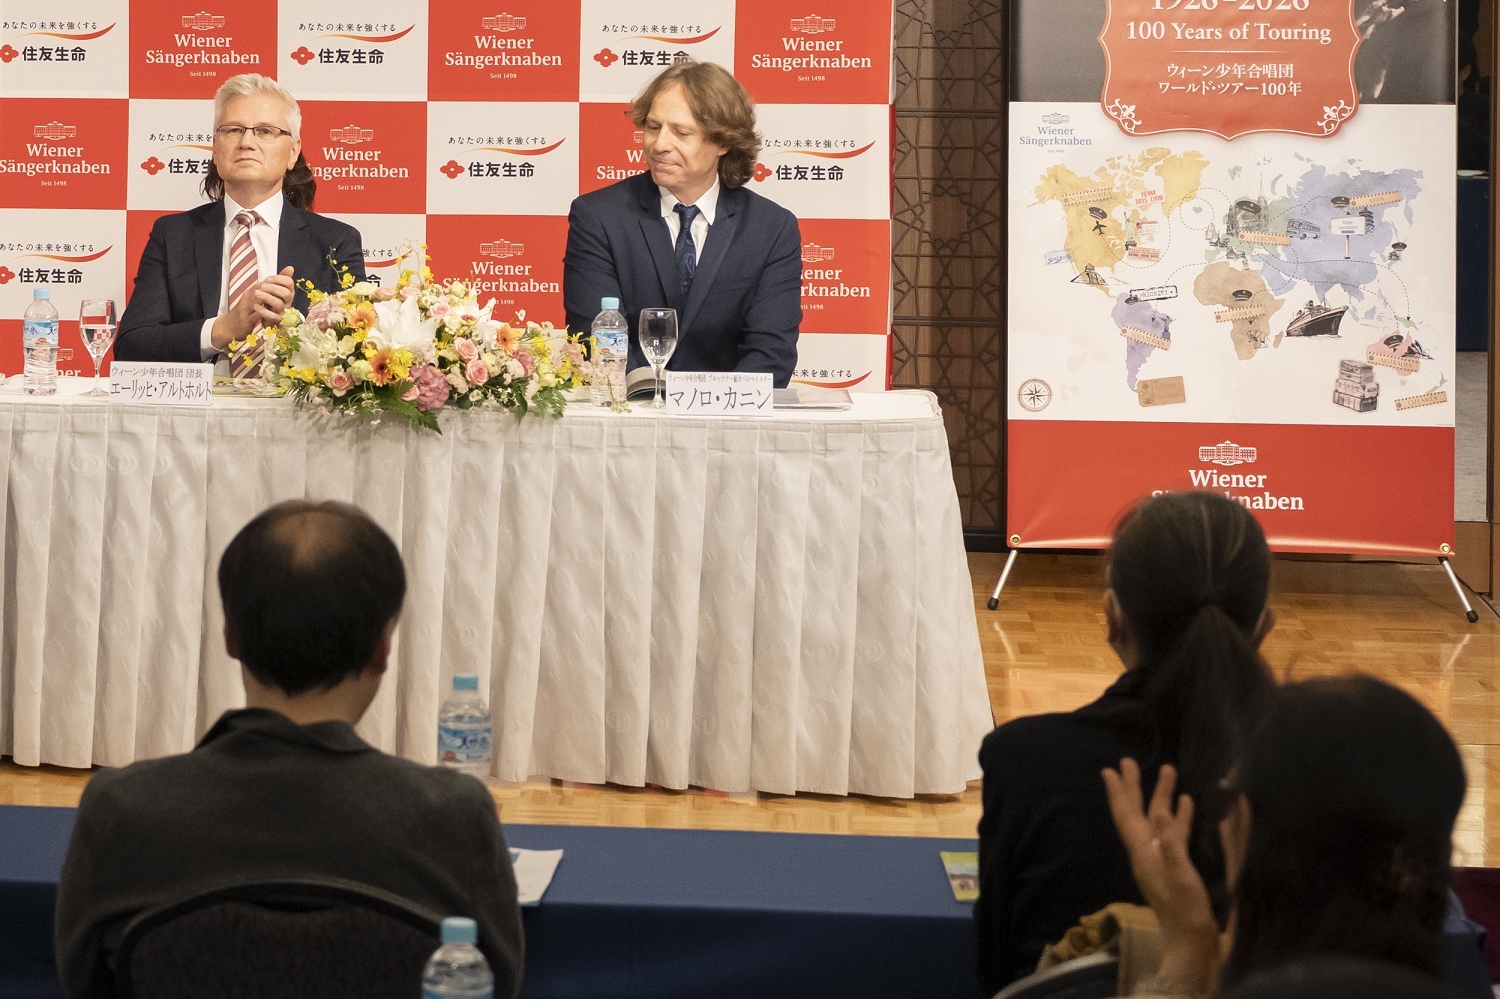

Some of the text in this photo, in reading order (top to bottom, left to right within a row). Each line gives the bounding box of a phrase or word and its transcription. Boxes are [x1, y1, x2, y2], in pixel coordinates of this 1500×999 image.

[300, 23, 396, 32] あなたの未来を強くする
[1126, 20, 1332, 45] 100 Years of Touring
[173, 33, 233, 48] Wiener
[473, 34, 535, 50] Wiener
[781, 36, 844, 52] Wiener
[21, 45, 87, 62] 住友生命
[145, 49, 260, 68] Sängerknaben
[318, 48, 385, 65] 住友生命
[445, 51, 563, 70] Sängerknaben
[751, 53, 872, 72] Sängerknaben
[1166, 62, 1295, 80] ウィーン少年合唱団
[1037, 125, 1075, 136] Wiener
[449, 136, 546, 145] あなたの未来を強くする
[1019, 136, 1092, 148] Sängerknaben
[25, 142, 84, 158] Wiener
[322, 146, 382, 161] Wiener
[308, 164, 409, 181] ngerknaben
[467, 161, 535, 178] 住友生命
[775, 164, 844, 181] 住友生命
[1253, 234, 1277, 243] EUROPA
[18, 267, 83, 284] 住友生命
[470, 260, 532, 276] Wiener
[800, 283, 871, 297] rknaben
[1139, 288, 1169, 299] PRIORITY
[111, 366, 204, 379] ウィーン少年合唱団 団長
[668, 386, 772, 411] マノロ・カニン
[1188, 469, 1268, 489] Wiener
